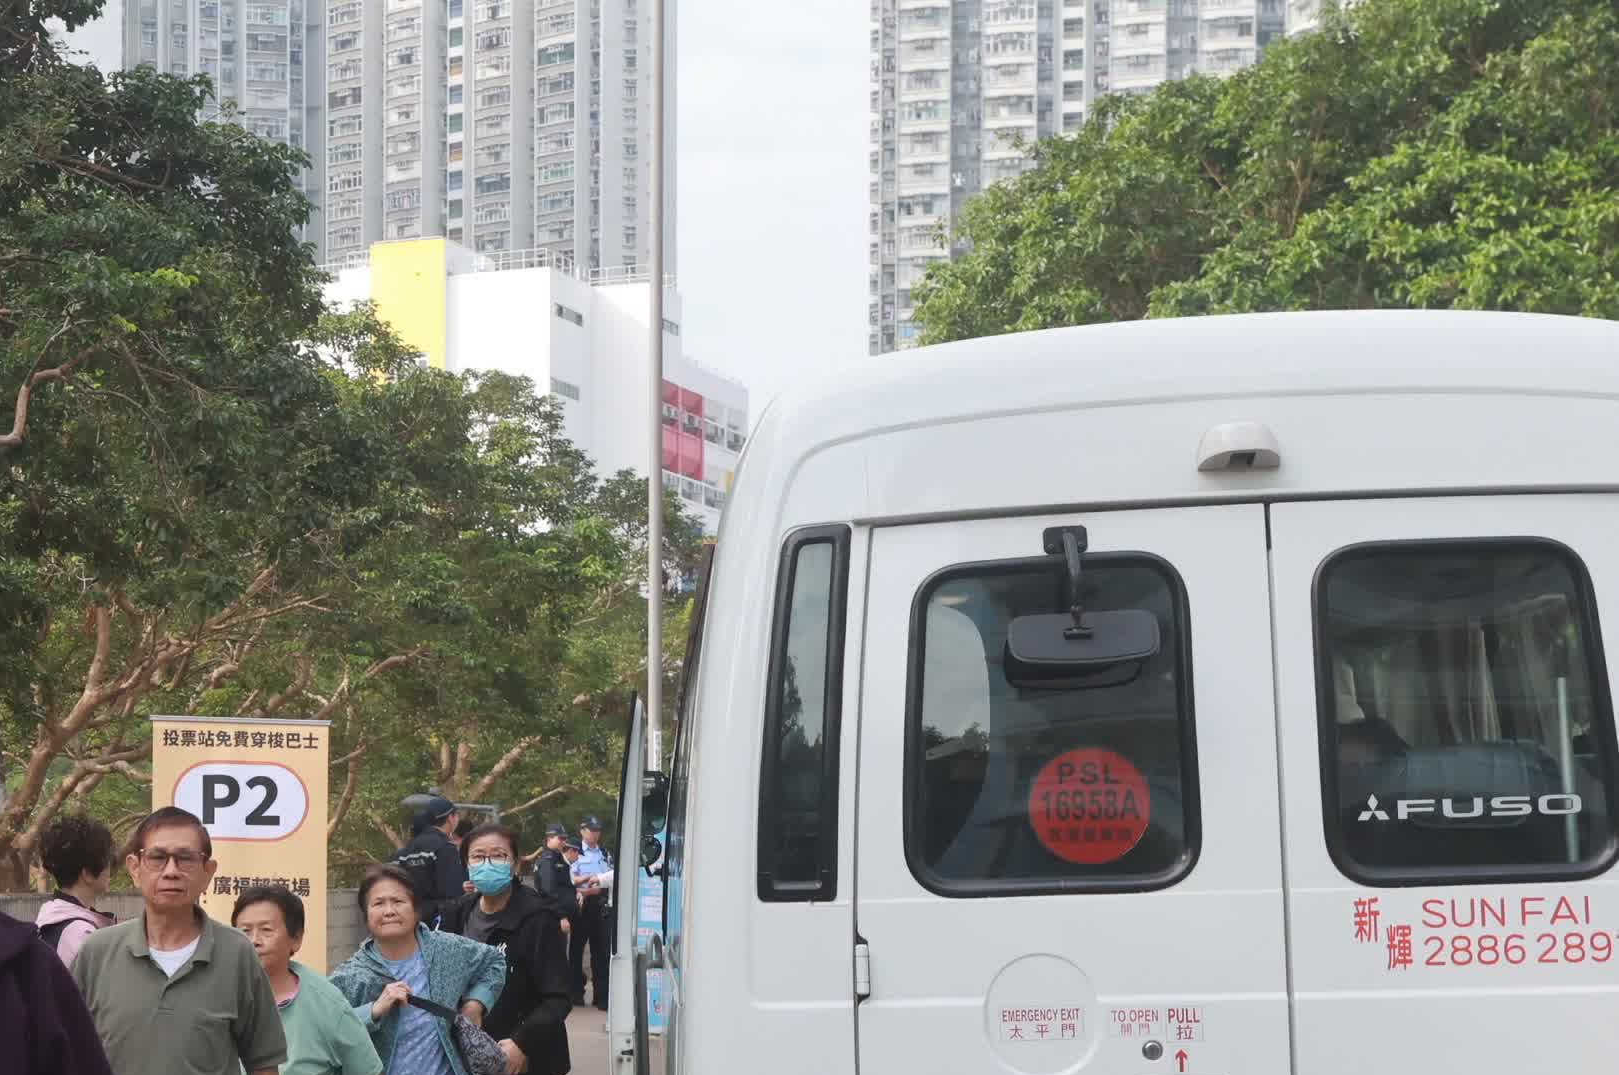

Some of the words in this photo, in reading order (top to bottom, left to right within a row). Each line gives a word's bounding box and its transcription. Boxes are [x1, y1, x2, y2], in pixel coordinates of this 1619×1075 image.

[163, 729, 319, 750] 投票站免費穿梭巴士
[1057, 761, 1120, 785] PSL
[202, 773, 281, 827] P2
[1397, 793, 1582, 820] FUSO
[1421, 896, 1506, 929] SUN
[1520, 895, 1591, 927] FAI
[1423, 933, 1527, 966] 2886
[1536, 931, 1619, 964] 289
[1002, 1009, 1059, 1023] EMERGENCY
[1060, 1008, 1081, 1021] EXIT
[1111, 1010, 1126, 1023] TO
[1127, 1009, 1159, 1023] OPEN
[1168, 1007, 1201, 1024] PULL
[1009, 1024, 1076, 1040] 太平門
[1176, 1025, 1195, 1041] 拉
